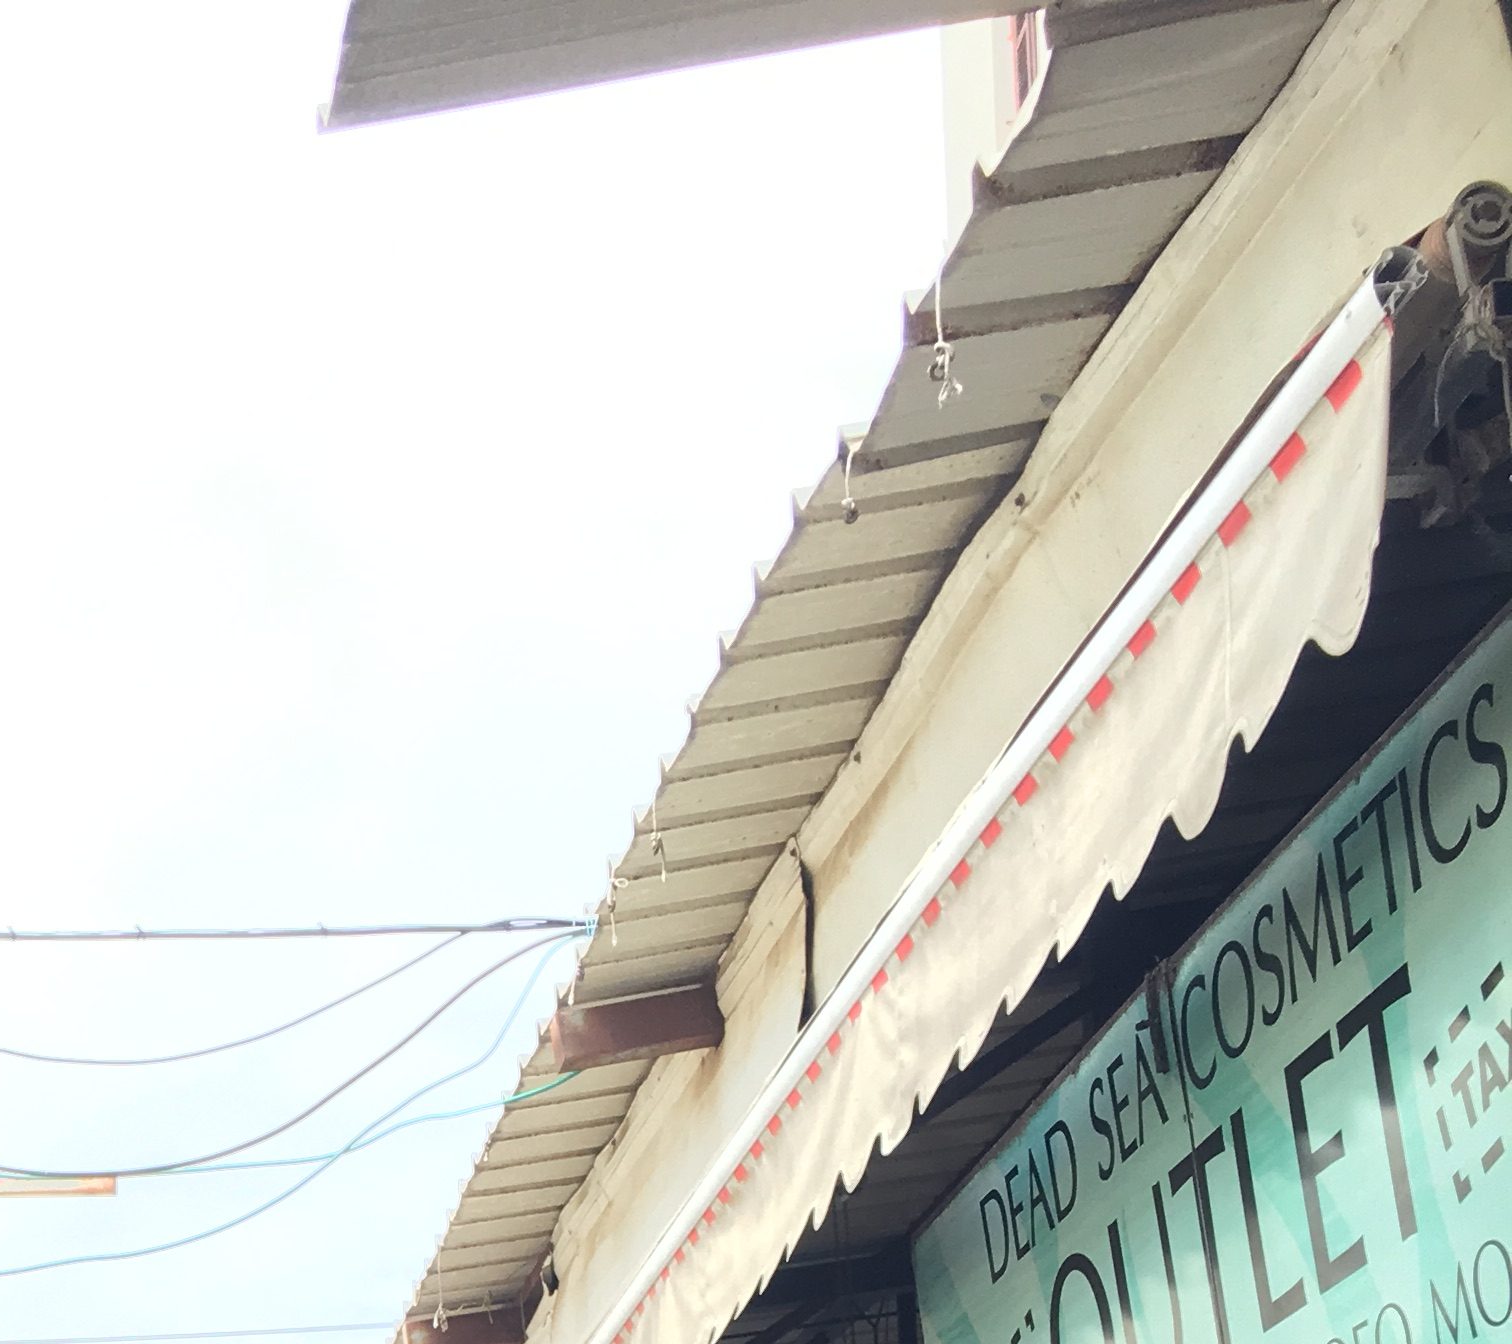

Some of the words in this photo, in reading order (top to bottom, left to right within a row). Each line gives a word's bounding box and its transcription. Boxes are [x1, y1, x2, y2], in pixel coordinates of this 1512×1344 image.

[979, 1119, 1078, 1284] DEAD
[1089, 1026, 1168, 1181] SEA
[1180, 683, 1507, 1090] COSMETICS
